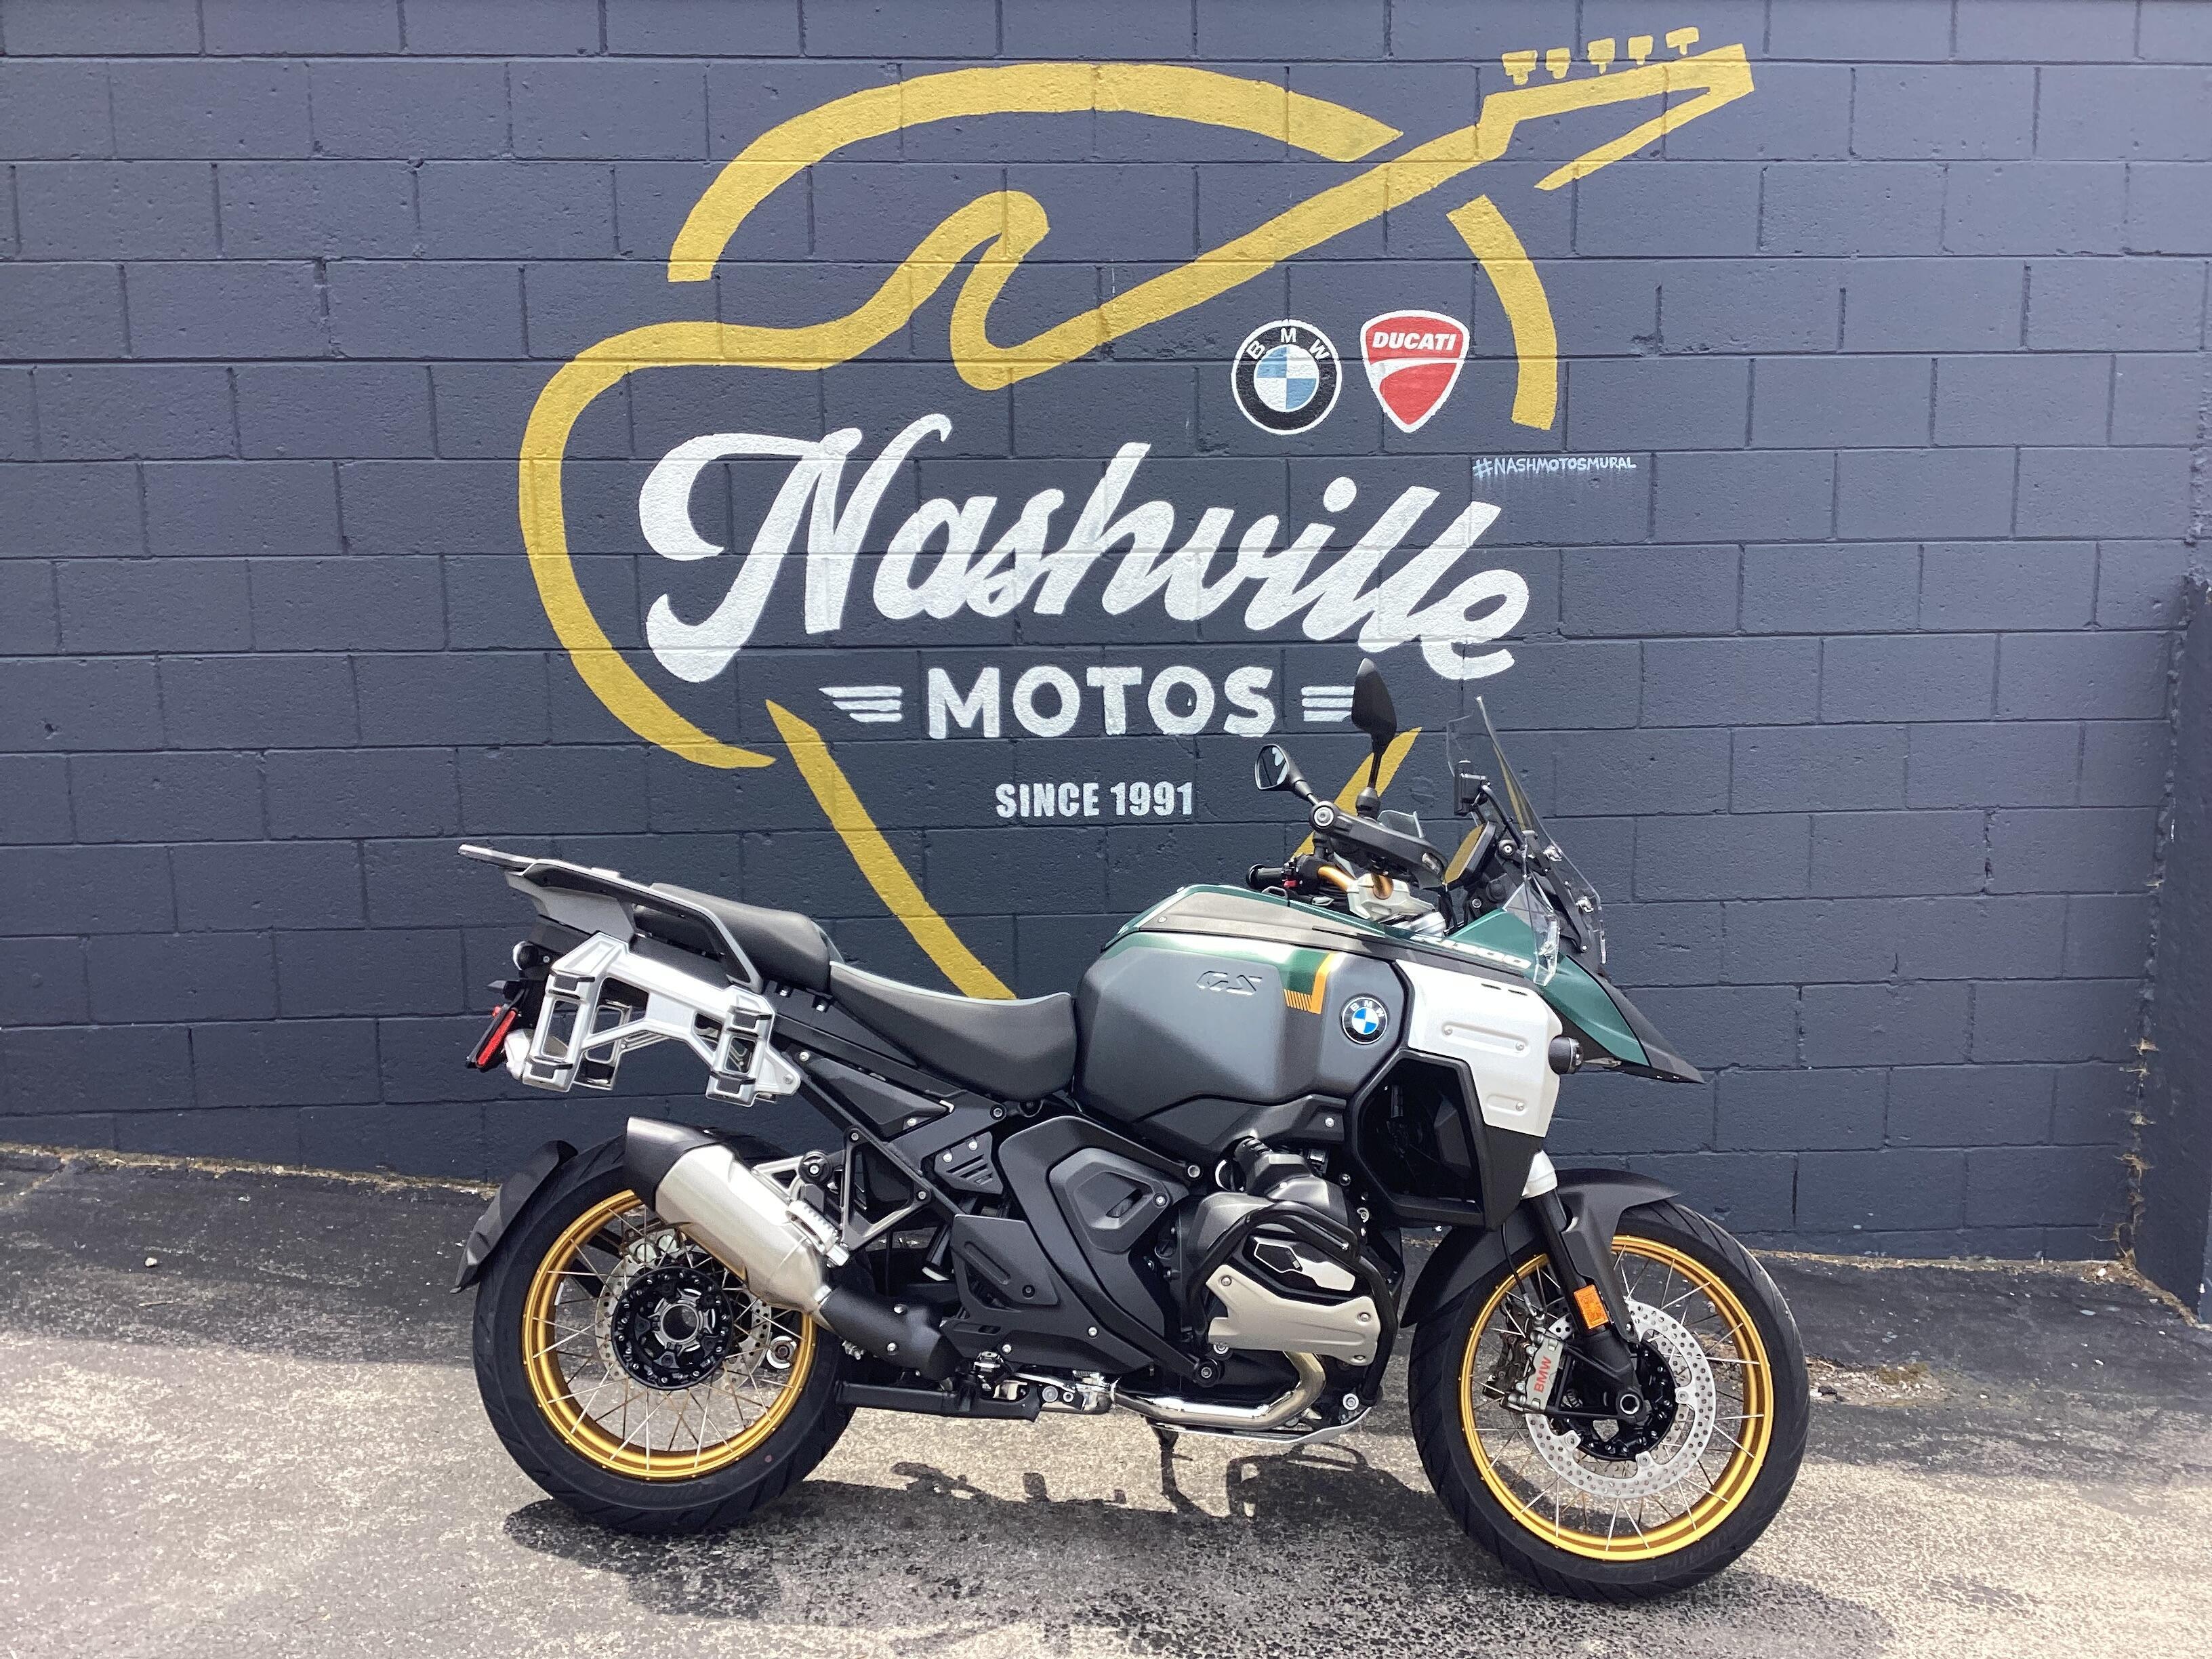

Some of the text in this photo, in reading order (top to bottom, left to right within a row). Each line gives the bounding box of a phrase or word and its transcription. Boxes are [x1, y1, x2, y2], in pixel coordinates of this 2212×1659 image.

[1246, 326, 1331, 361] BMW
[1372, 331, 1457, 351] DUCATI
[1472, 455, 1637, 478] #NASHMOTOSMURAL
[638, 413, 1530, 682] Nashville
[927, 665, 1275, 739] MOTOS
[995, 781, 1193, 818] SINCE 1991
[1349, 1000, 1385, 1018] BMW
[1534, 1355, 1552, 1393] BMW
